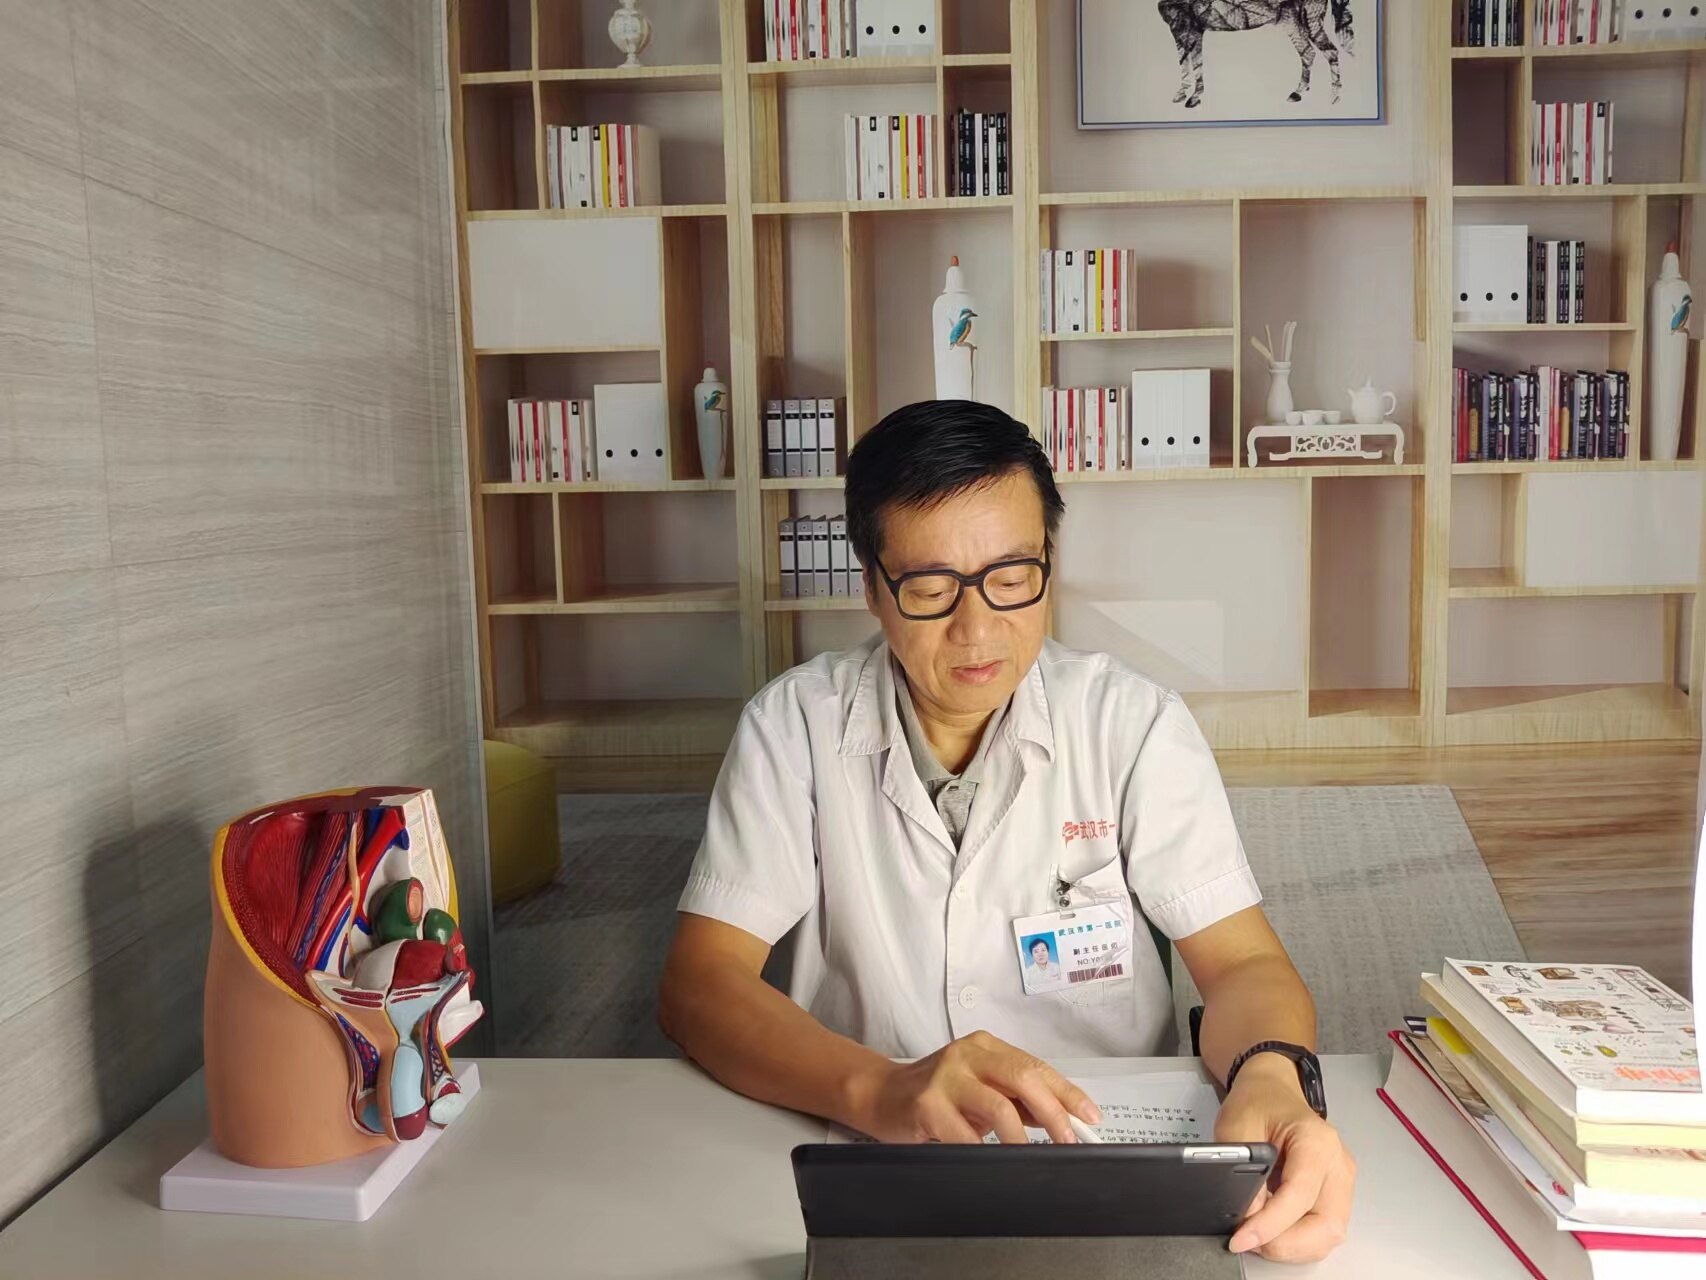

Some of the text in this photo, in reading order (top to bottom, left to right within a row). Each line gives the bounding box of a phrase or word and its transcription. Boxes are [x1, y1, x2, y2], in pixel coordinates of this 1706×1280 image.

[1058, 919, 1122, 937] 武汉市第一医院
[1073, 942, 1119, 956] 副主任医师
